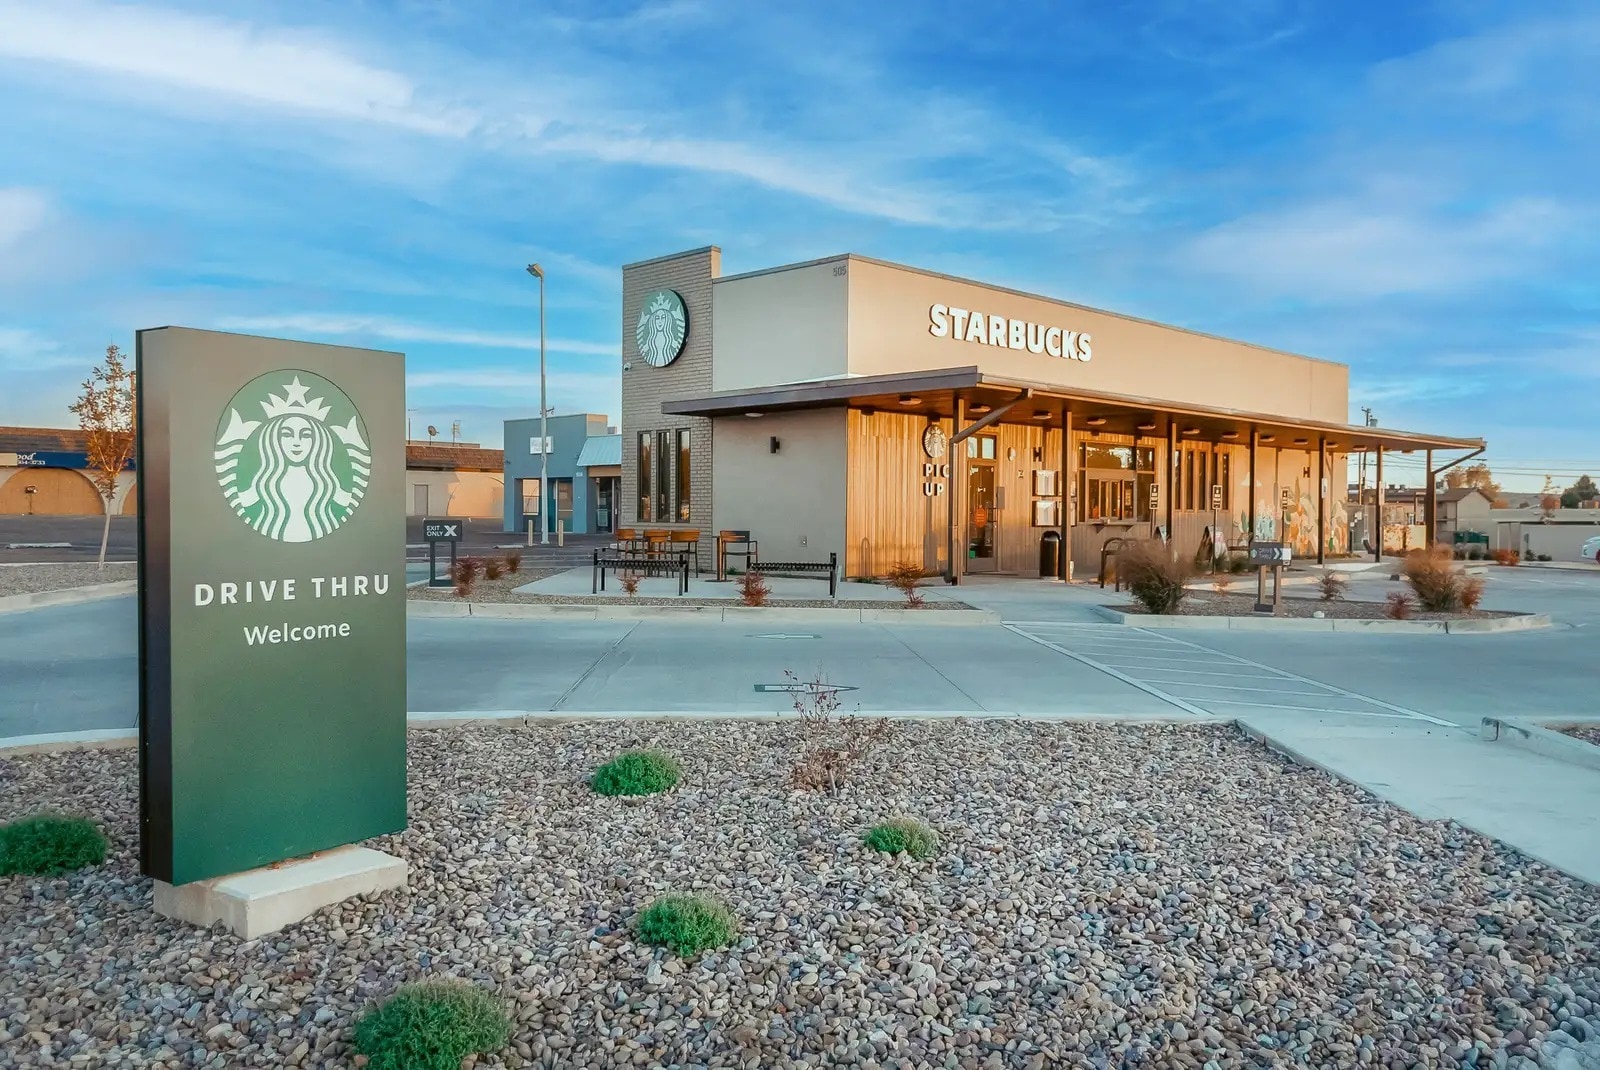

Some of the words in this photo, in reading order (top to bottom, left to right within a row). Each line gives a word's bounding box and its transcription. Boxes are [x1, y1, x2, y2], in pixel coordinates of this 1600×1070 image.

[929, 304, 1092, 362] STARBUCKS
[923, 463, 950, 478] PIC
[923, 482, 944, 497] UP
[194, 579, 296, 607] DRIVE
[311, 574, 389, 598] THRU
[243, 622, 351, 646] Welcome
